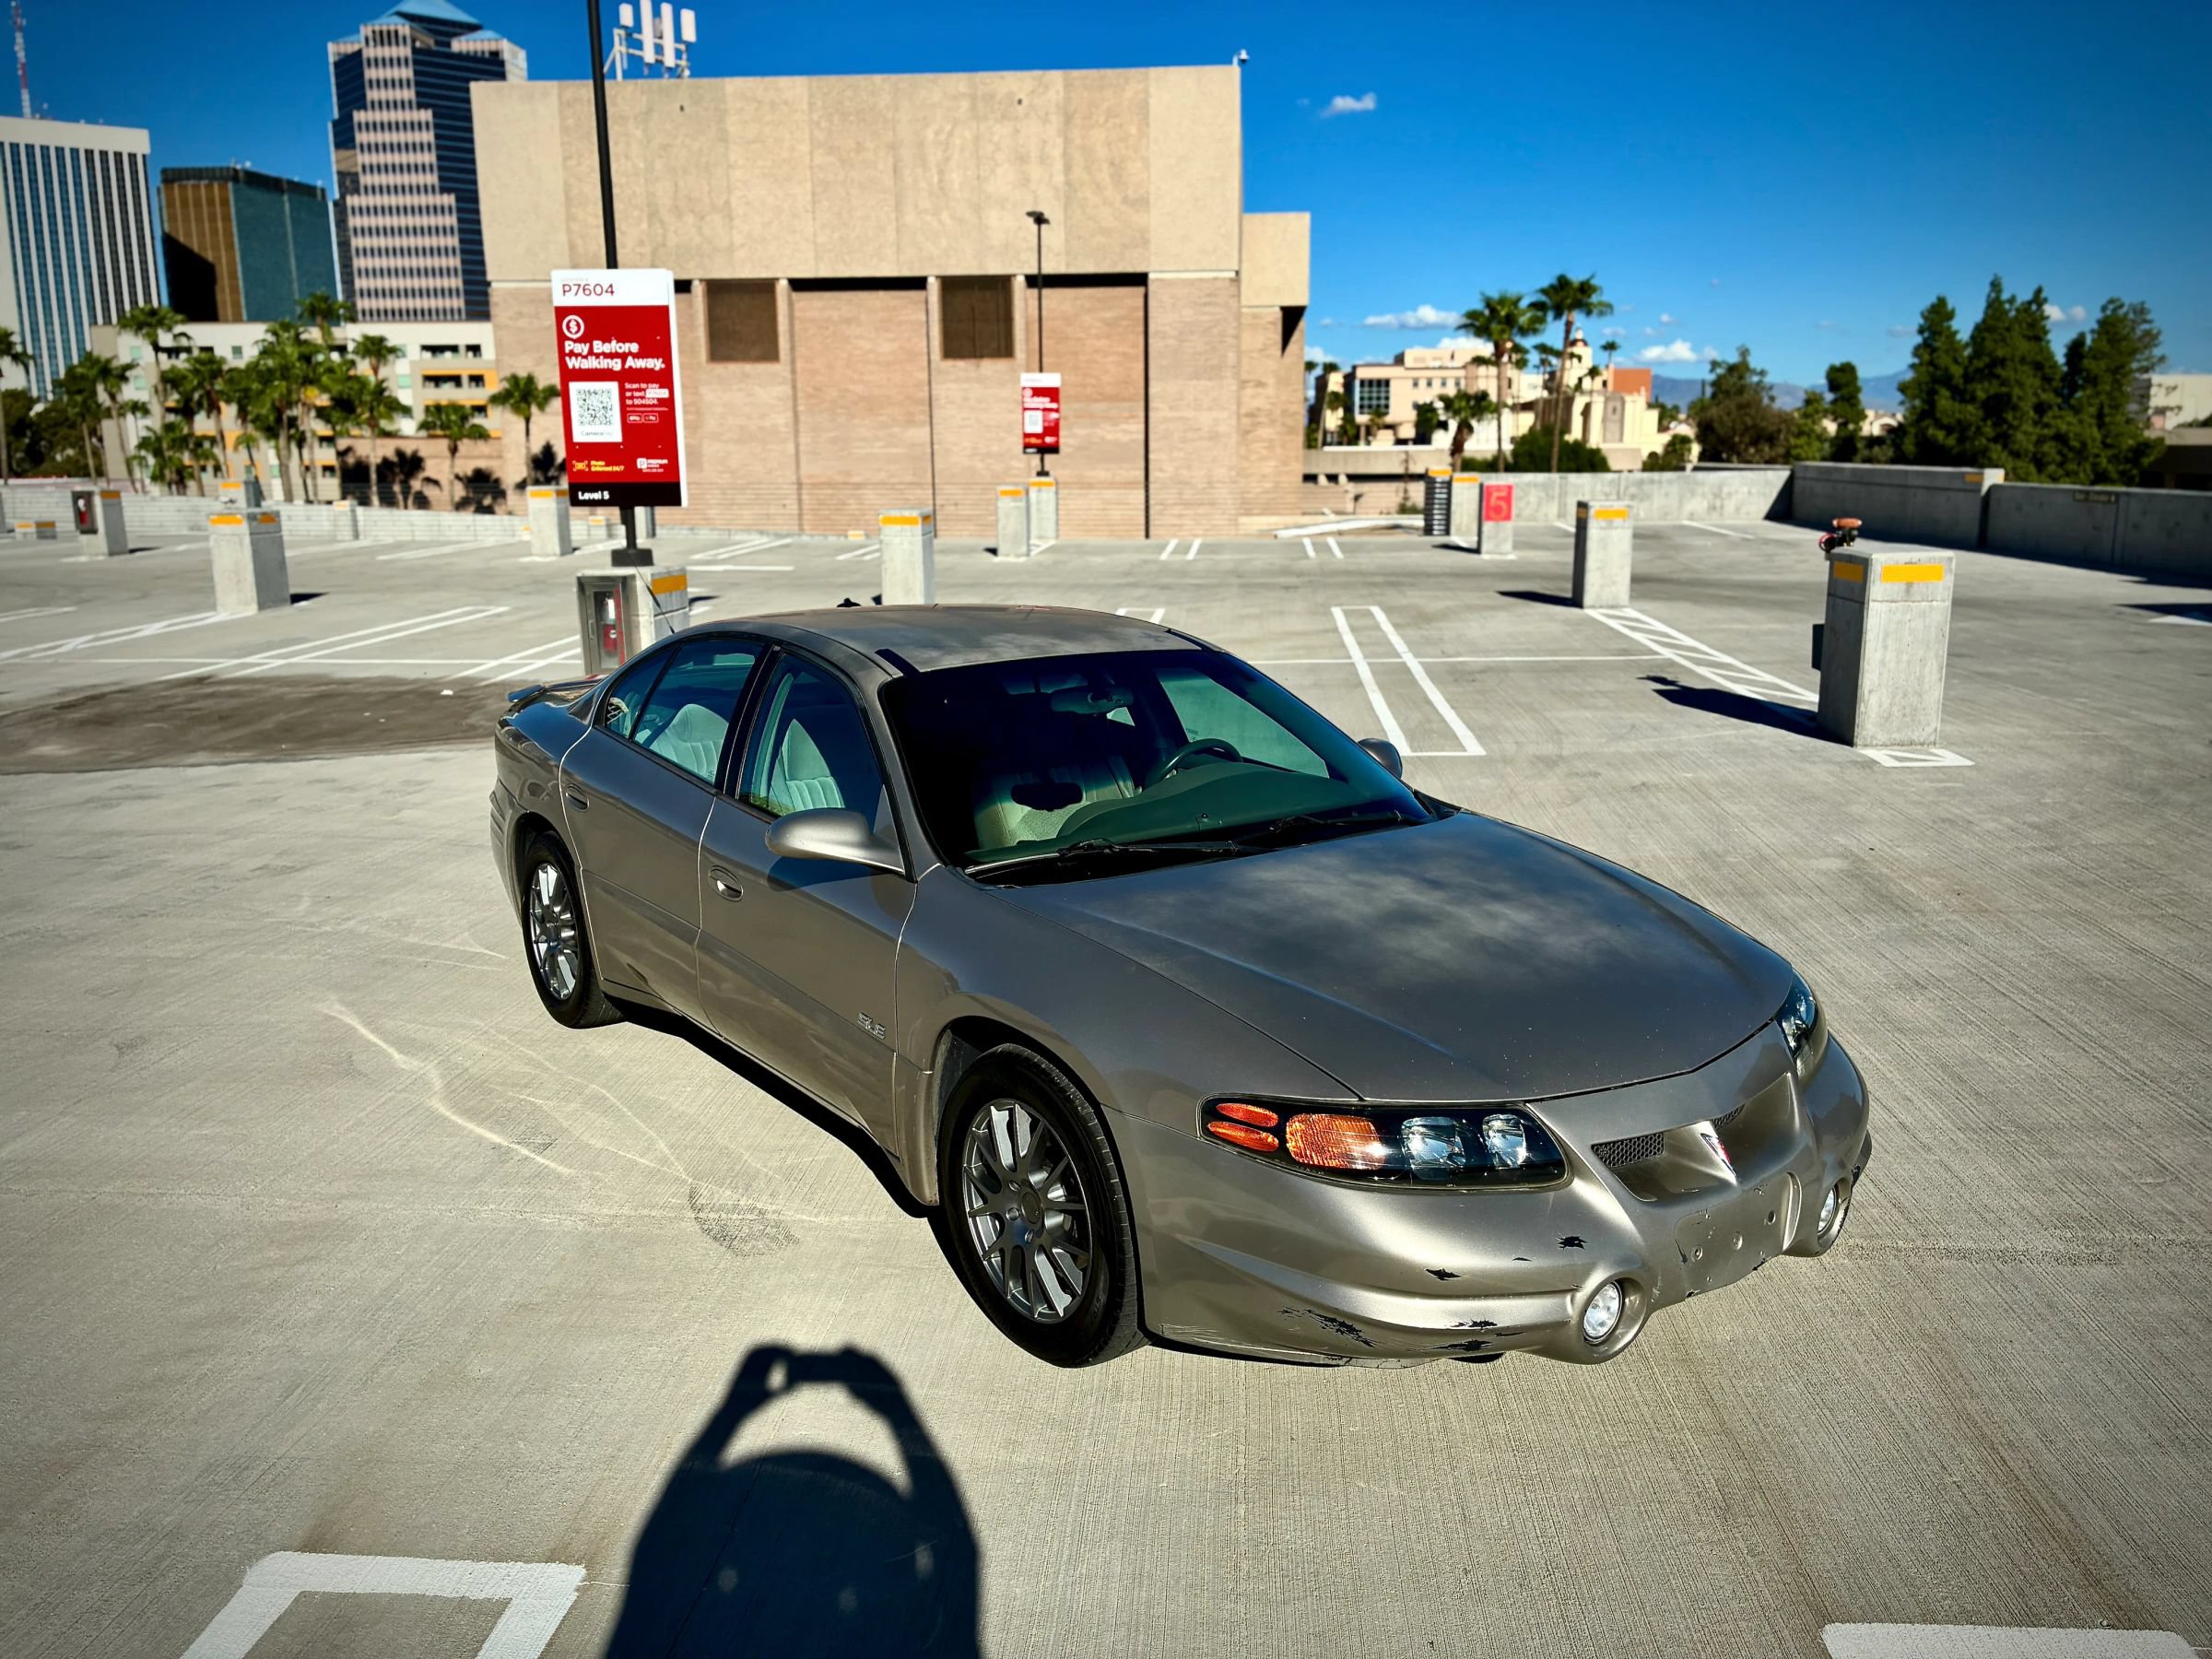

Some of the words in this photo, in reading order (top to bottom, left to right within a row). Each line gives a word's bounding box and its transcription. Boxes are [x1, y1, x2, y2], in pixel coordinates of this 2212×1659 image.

[562, 283, 615, 297] P7604
[564, 341, 589, 355] Pay
[593, 340, 639, 353] Before
[565, 356, 621, 371] Walking
[625, 356, 665, 370] Away.
[578, 490, 602, 500] Level
[603, 490, 610, 500] 5
[1489, 490, 1509, 521] 5
